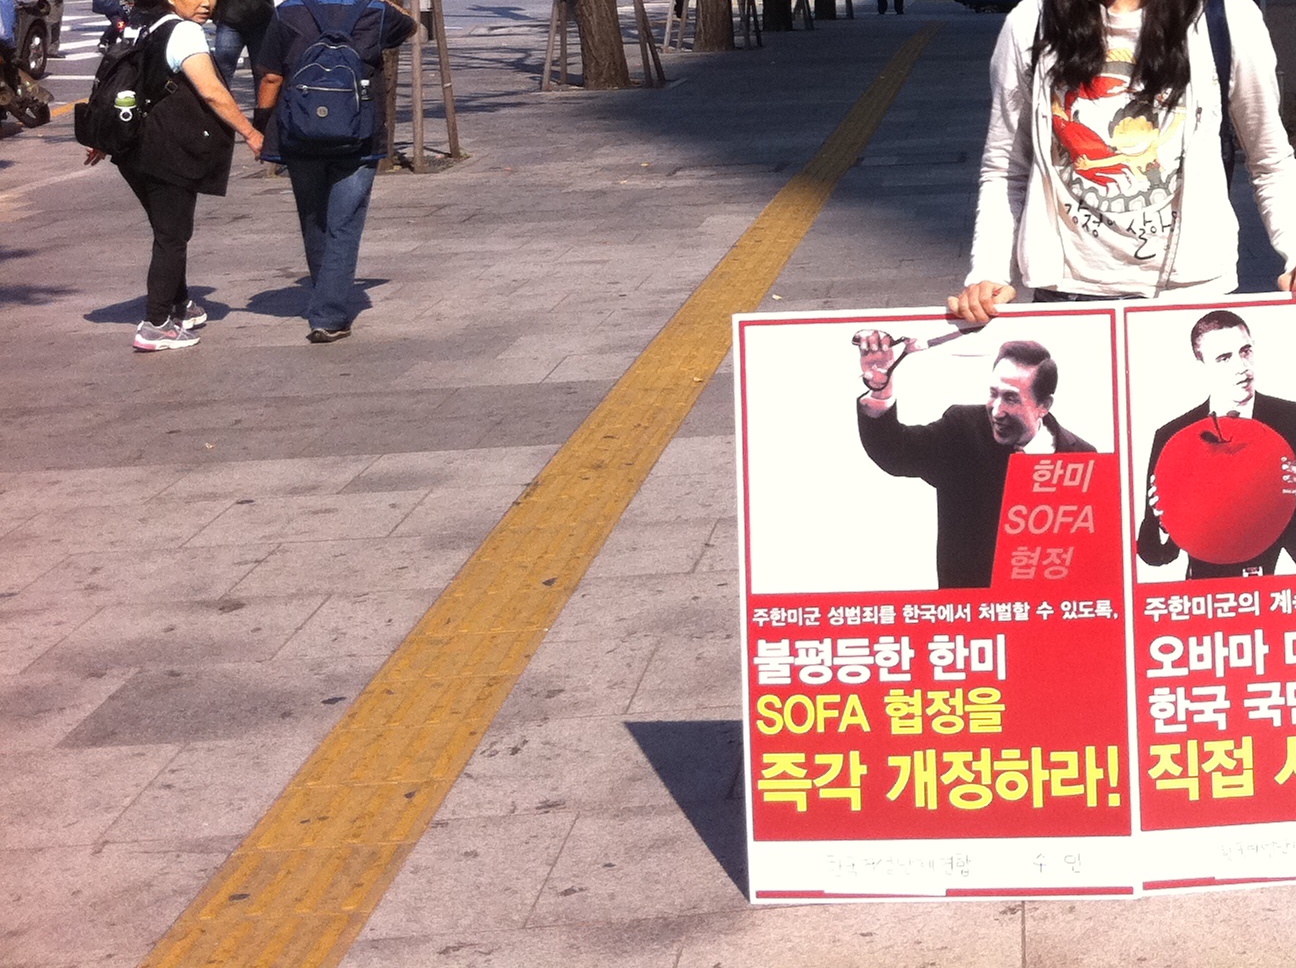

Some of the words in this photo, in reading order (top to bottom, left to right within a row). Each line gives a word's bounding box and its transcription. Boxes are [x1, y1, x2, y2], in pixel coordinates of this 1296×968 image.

[1032, 459, 1096, 493] 한미
[1004, 504, 1095, 534] SOFA
[1010, 545, 1075, 580] 협정
[752, 607, 821, 627] 주한미군
[827, 605, 897, 626] 성범죄를
[902, 603, 972, 624] 한국에서
[978, 601, 1031, 622] 처벌할
[1036, 600, 1055, 620] 수
[1060, 599, 1119, 620] 있도록,
[1144, 590, 1261, 622] 주한미군의
[753, 636, 915, 685] 불평등한
[928, 633, 1006, 681] 한미
[1146, 628, 1269, 679] 오바마
[756, 693, 871, 735] SOFA
[884, 687, 1006, 735] 협정을
[1149, 684, 1231, 734] 한국
[757, 750, 868, 812] 즉각
[886, 745, 1121, 810] 개정하라!
[1148, 735, 1255, 801] 직접
